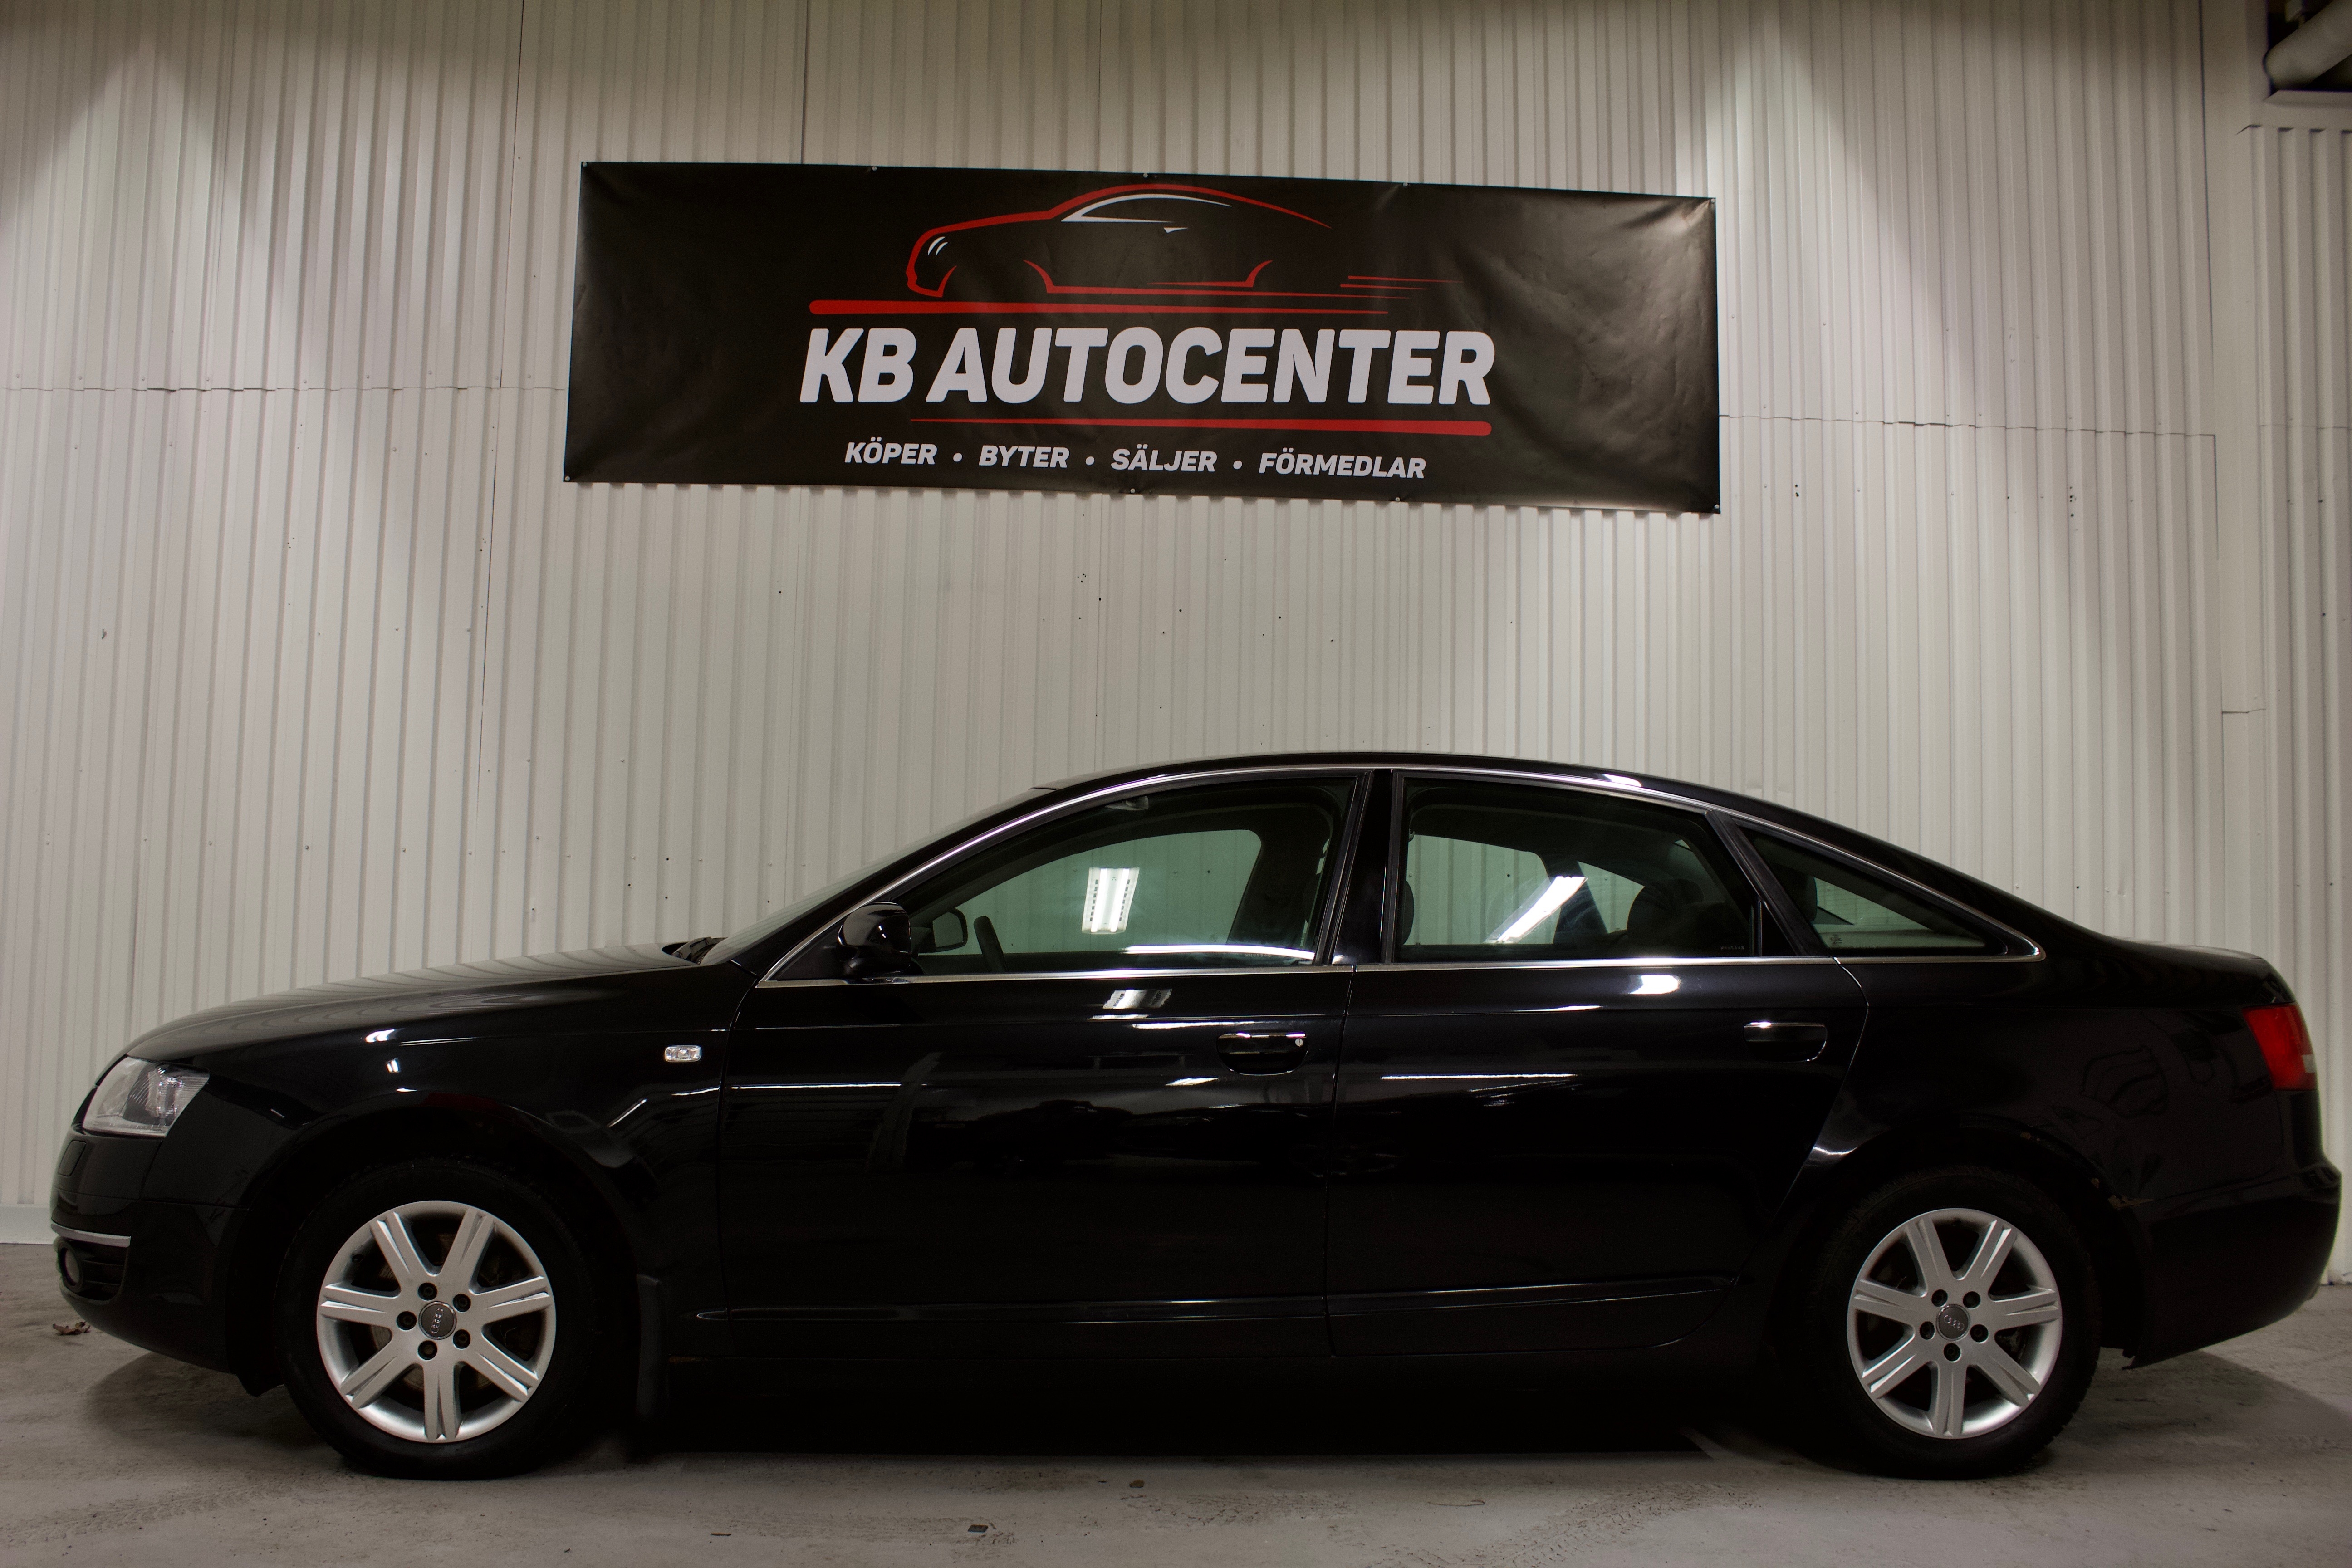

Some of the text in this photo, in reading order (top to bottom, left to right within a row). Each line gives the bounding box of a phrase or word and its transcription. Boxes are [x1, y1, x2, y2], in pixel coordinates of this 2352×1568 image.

[800, 327, 1494, 405] KB AUTOCENTER
[845, 437, 1426, 478] KÖPER BYTER SÄLJER FÖRMEDLAR
